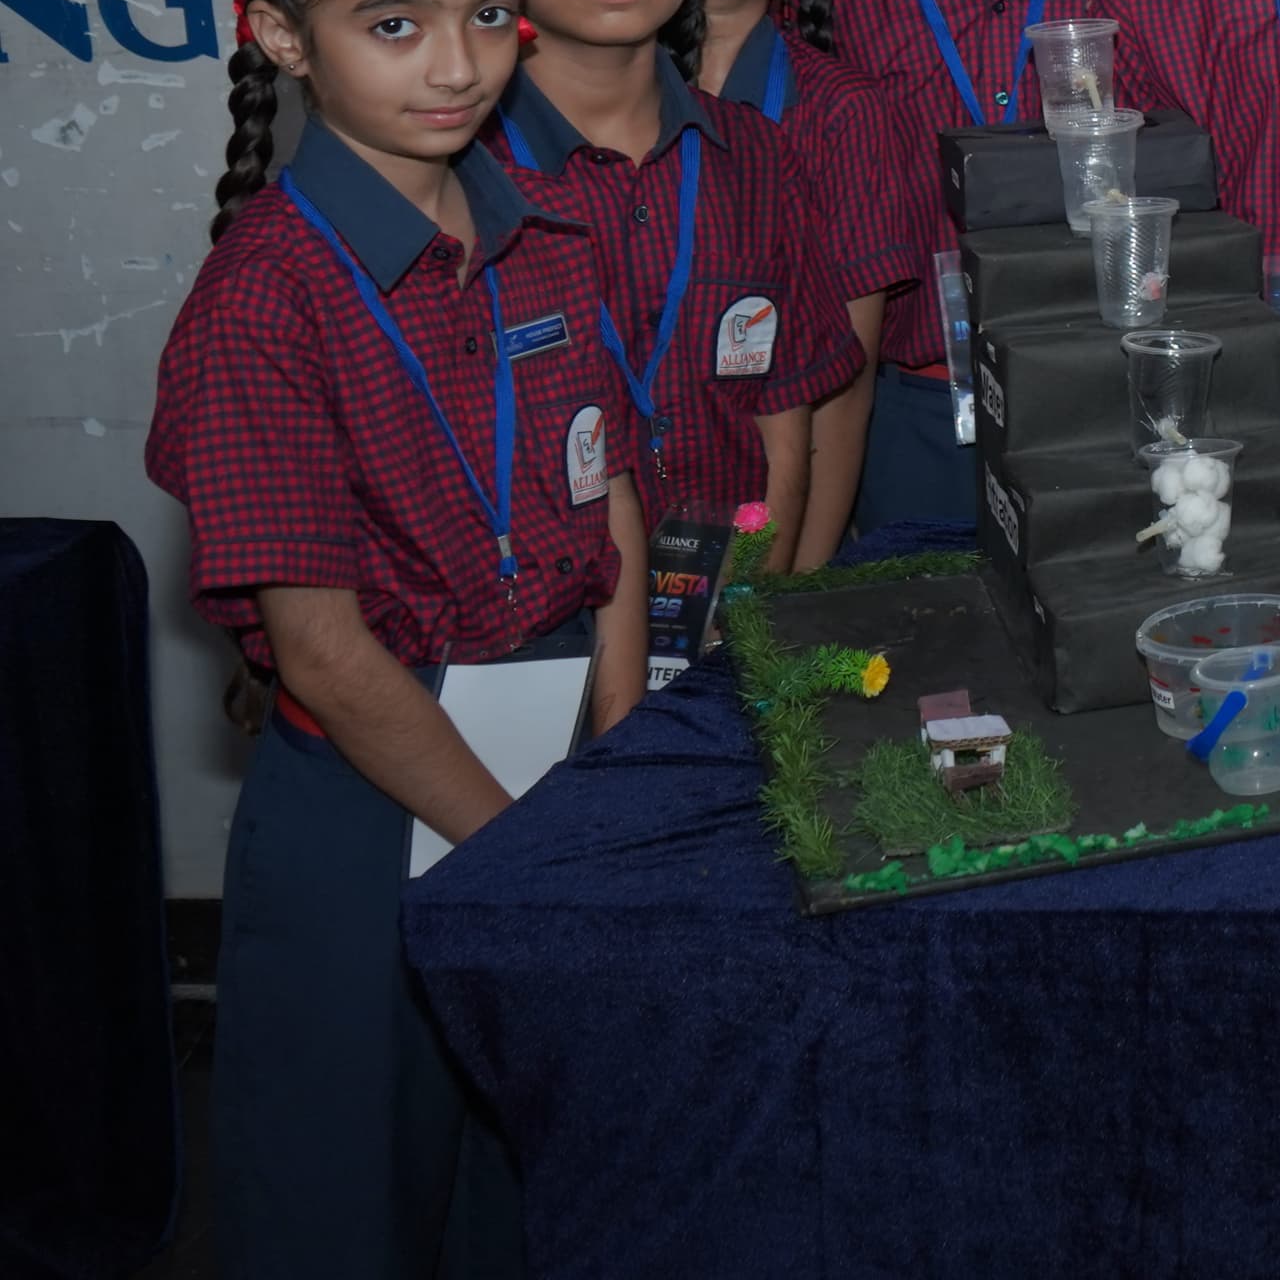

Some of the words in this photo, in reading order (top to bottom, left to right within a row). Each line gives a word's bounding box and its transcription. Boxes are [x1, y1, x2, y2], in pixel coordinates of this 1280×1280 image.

[721, 351, 768, 367] ALLIANCE
[659, 535, 701, 550] ALLIANCE
[650, 597, 683, 618] 26
